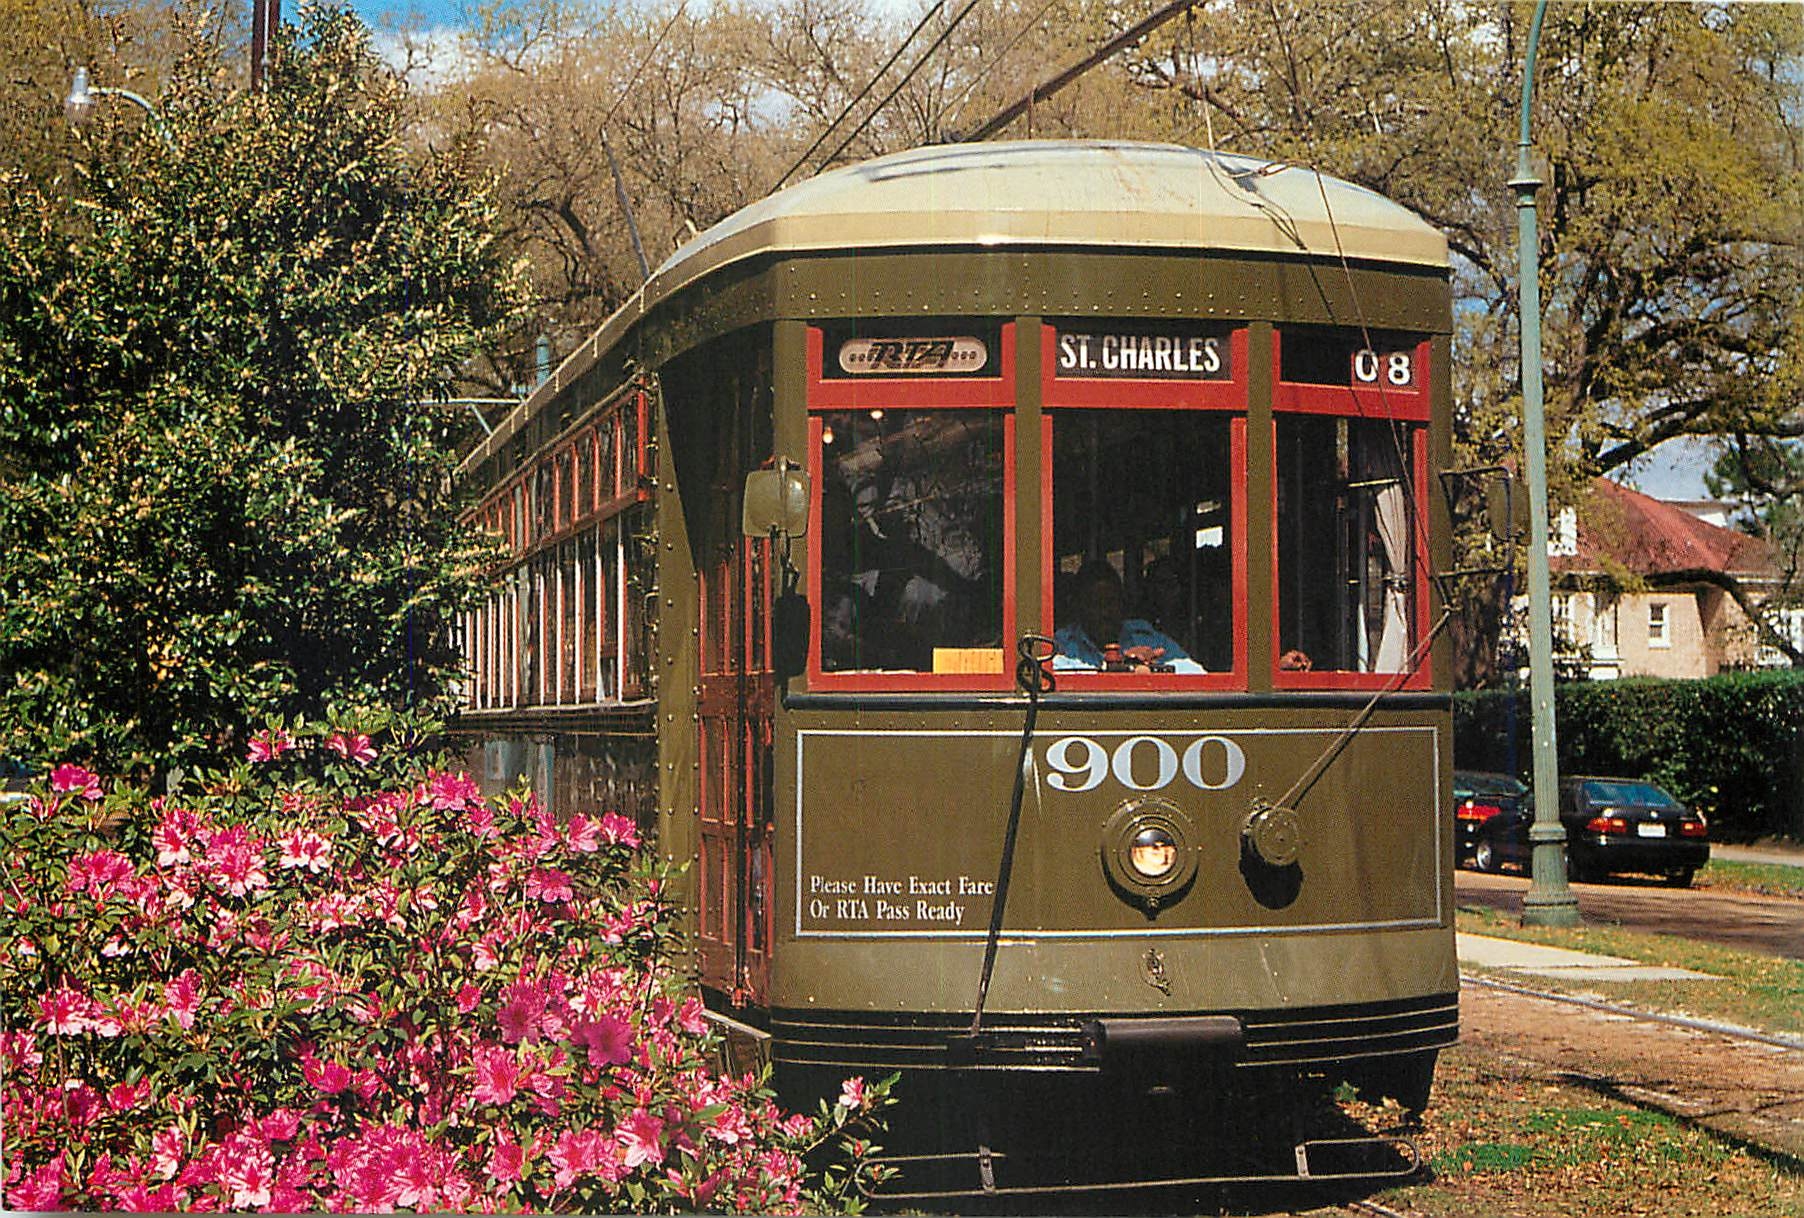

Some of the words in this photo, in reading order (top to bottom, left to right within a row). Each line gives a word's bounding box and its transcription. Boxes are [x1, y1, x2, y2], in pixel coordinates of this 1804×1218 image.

[866, 340, 955, 370] RTA
[1060, 333, 1097, 368] ST.
[1102, 334, 1221, 372] CHARLES
[1045, 736, 1246, 792] 900
[809, 875, 857, 894] Please
[864, 875, 902, 895] Have
[909, 876, 951, 895] Exact
[958, 876, 993, 895] Fare
[809, 899, 830, 919] Or
[837, 899, 869, 920] RTA
[876, 899, 910, 921] Pass
[916, 900, 966, 926] Ready
